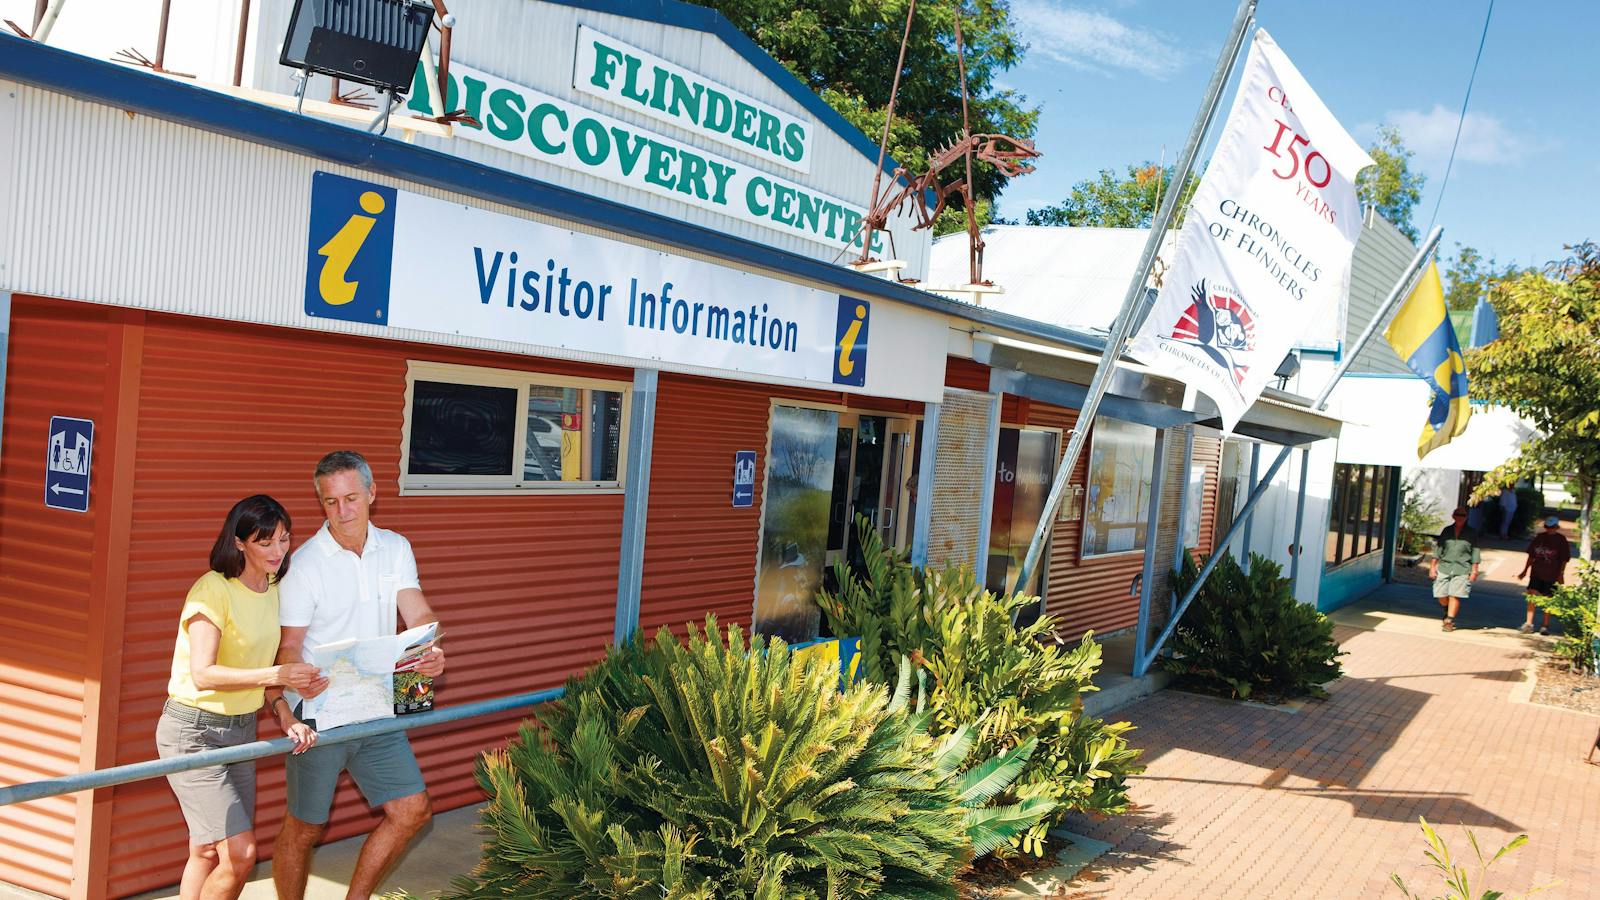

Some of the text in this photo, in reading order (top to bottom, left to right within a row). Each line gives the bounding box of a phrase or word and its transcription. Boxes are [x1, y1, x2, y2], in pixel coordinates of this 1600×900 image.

[407, 59, 737, 206] DISCOVERY
[590, 40, 805, 162] FLINDERS
[1263, 118, 1331, 188] 150
[1219, 199, 1322, 282] CHRONICLES
[1295, 181, 1337, 225] YEARS
[473, 246, 799, 353] Visitor Information
[1208, 222, 1234, 241] OF
[1236, 233, 1307, 301] FLINDERS
[997, 461, 1015, 483] to
